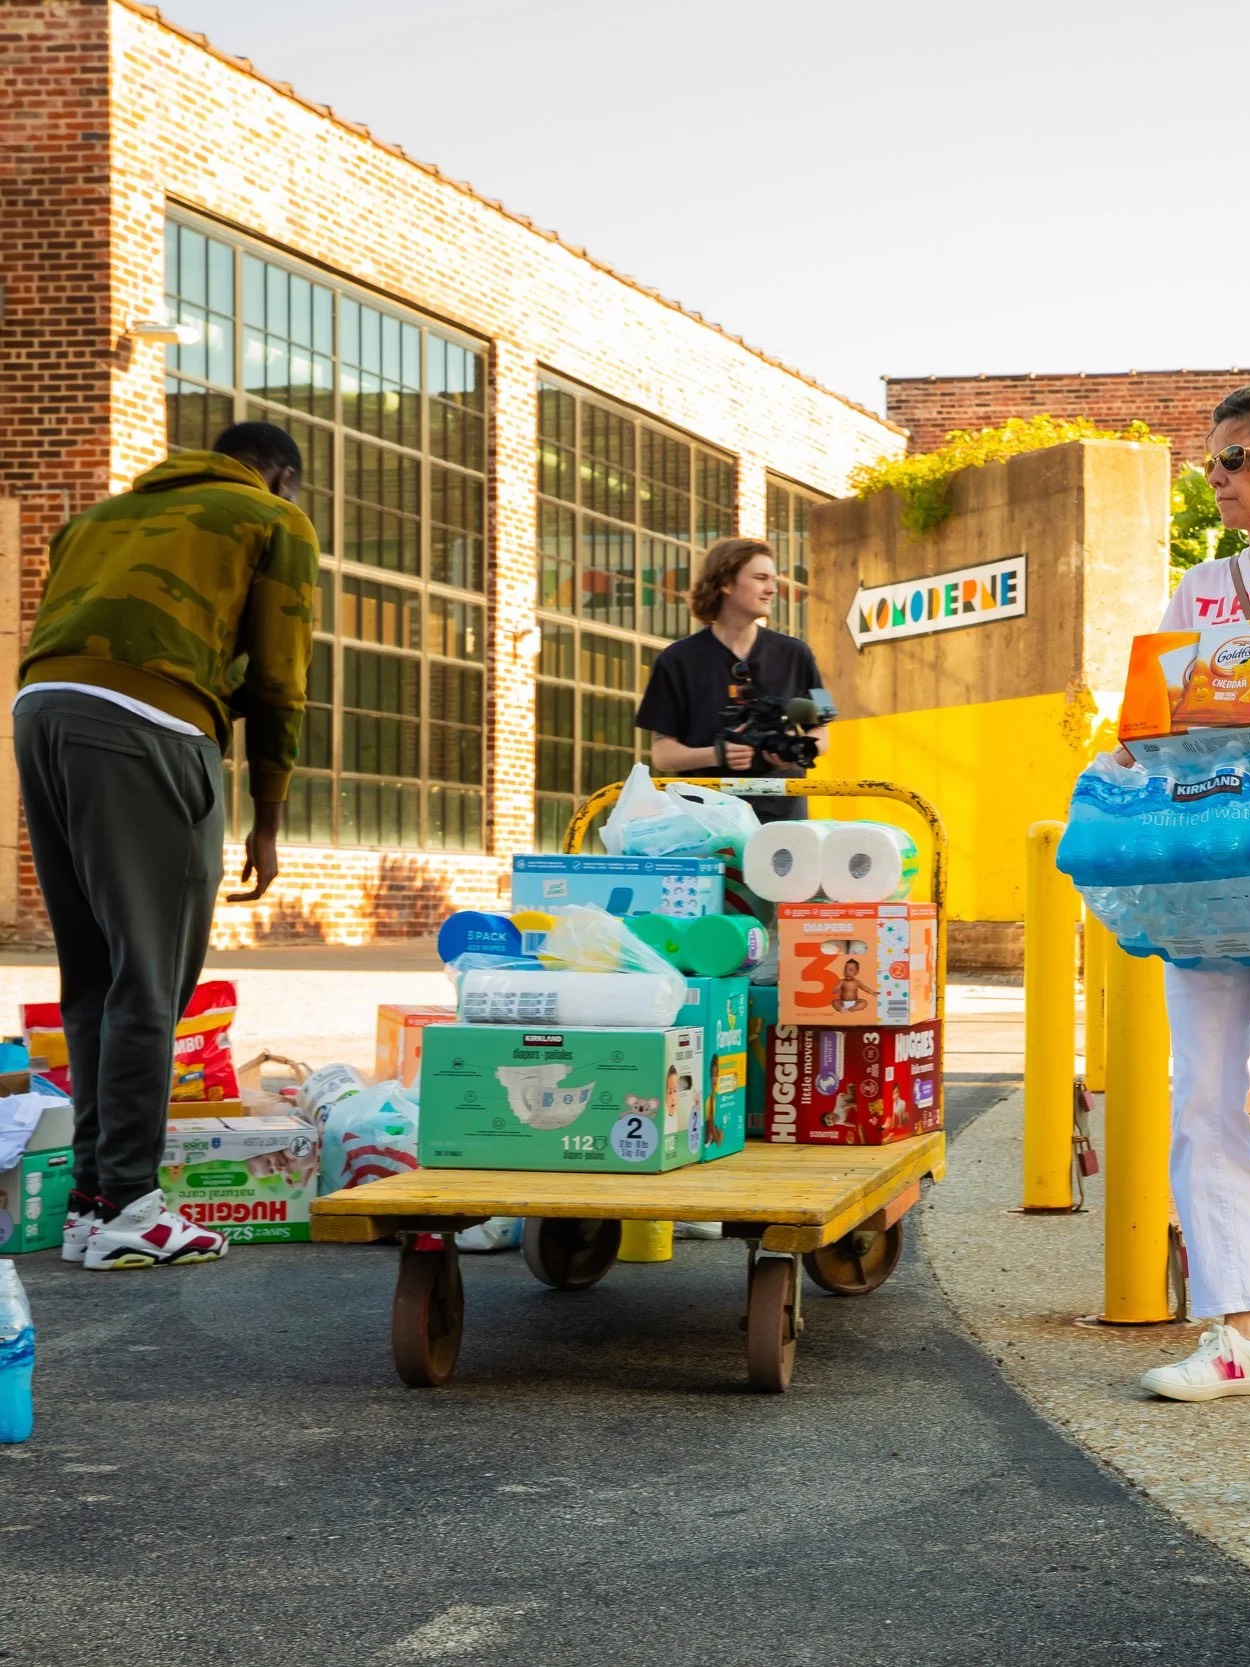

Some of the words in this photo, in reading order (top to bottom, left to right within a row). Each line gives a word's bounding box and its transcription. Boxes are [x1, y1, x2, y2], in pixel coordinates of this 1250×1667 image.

[859, 570, 1017, 634] MOMODERNE
[1212, 678, 1247, 689] CHEDDAR
[1177, 776, 1241, 796] KIRKLAND
[1142, 808, 1210, 828] purified
[467, 930, 474, 941] 5
[475, 931, 507, 942] PACK
[803, 922, 854, 932] DIAPERS
[794, 942, 841, 1009] 3
[863, 1032, 880, 1045] 3
[803, 1030, 814, 1071] movers
[771, 1024, 799, 1143] HUGGIES
[801, 1072, 813, 1105] little
[627, 1118, 642, 1139] 2
[561, 1135, 594, 1150] 112
[179, 1190, 208, 1199] care
[208, 1188, 256, 1200] natural
[179, 1200, 287, 1223] HUGGIES
